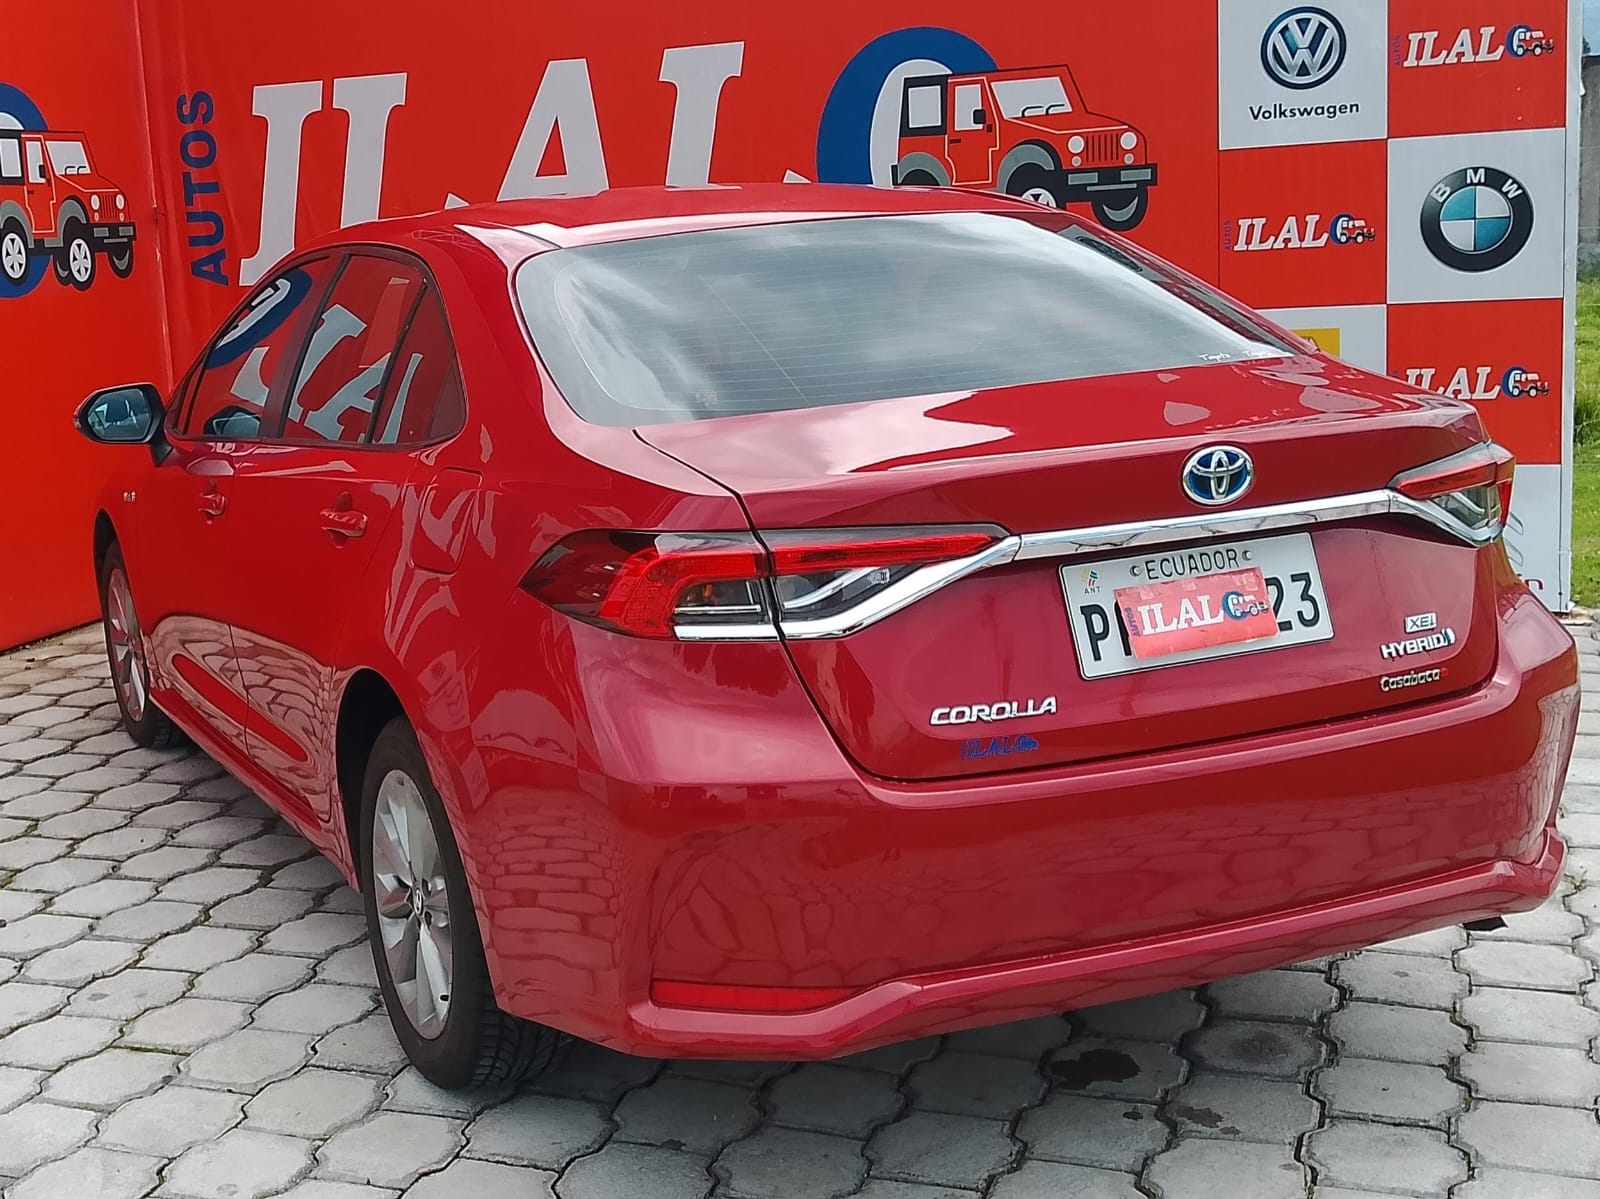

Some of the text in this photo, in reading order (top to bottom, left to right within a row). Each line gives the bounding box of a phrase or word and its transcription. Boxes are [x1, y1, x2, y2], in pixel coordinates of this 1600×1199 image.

[1249, 103, 1360, 120] Volkswagen
[177, 91, 229, 286] AUTOS
[1430, 168, 1523, 203] BMW
[1145, 549, 1240, 580] ECUADOR
[1084, 585, 1101, 595] ANT
[1124, 607, 1141, 637] AUTOS
[1380, 633, 1449, 659] HYBRID
[930, 696, 1057, 726] COROLLA
